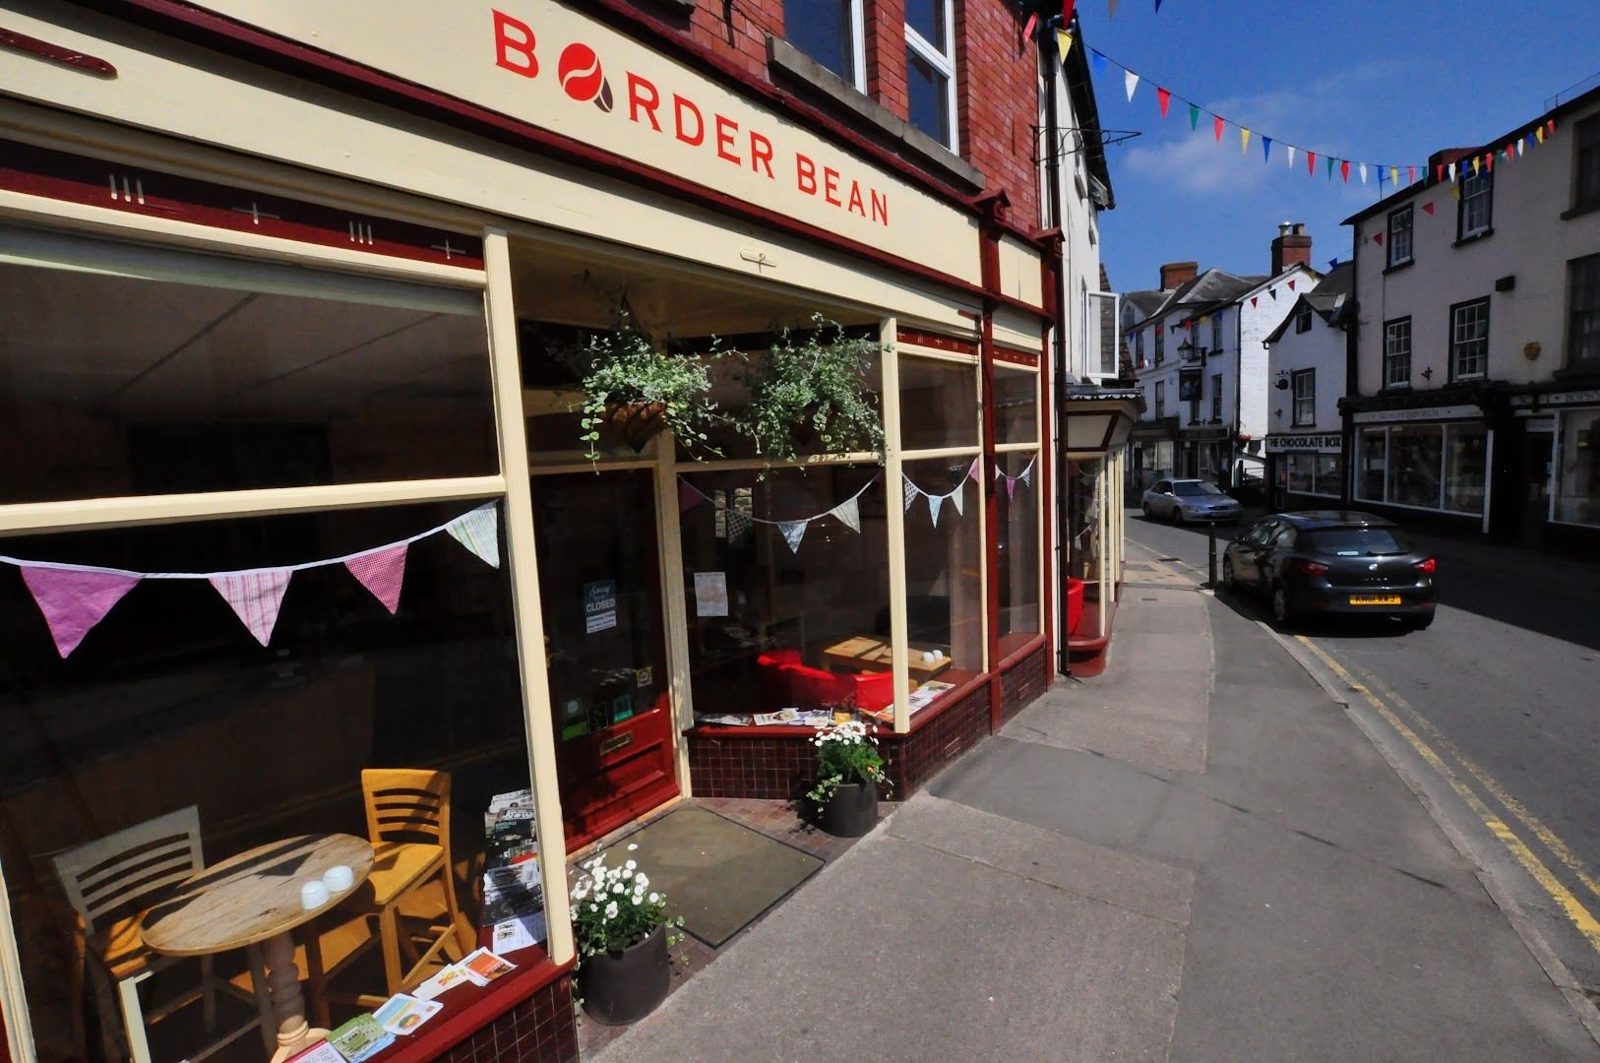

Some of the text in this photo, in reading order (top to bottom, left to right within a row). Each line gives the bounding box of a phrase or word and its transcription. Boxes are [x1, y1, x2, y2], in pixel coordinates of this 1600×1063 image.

[796, 152, 889, 227] BEAN
[1280, 437, 1323, 448] CHOCOLATE
[1324, 436, 1341, 448] BOX
[586, 598, 616, 613] CLOSED
